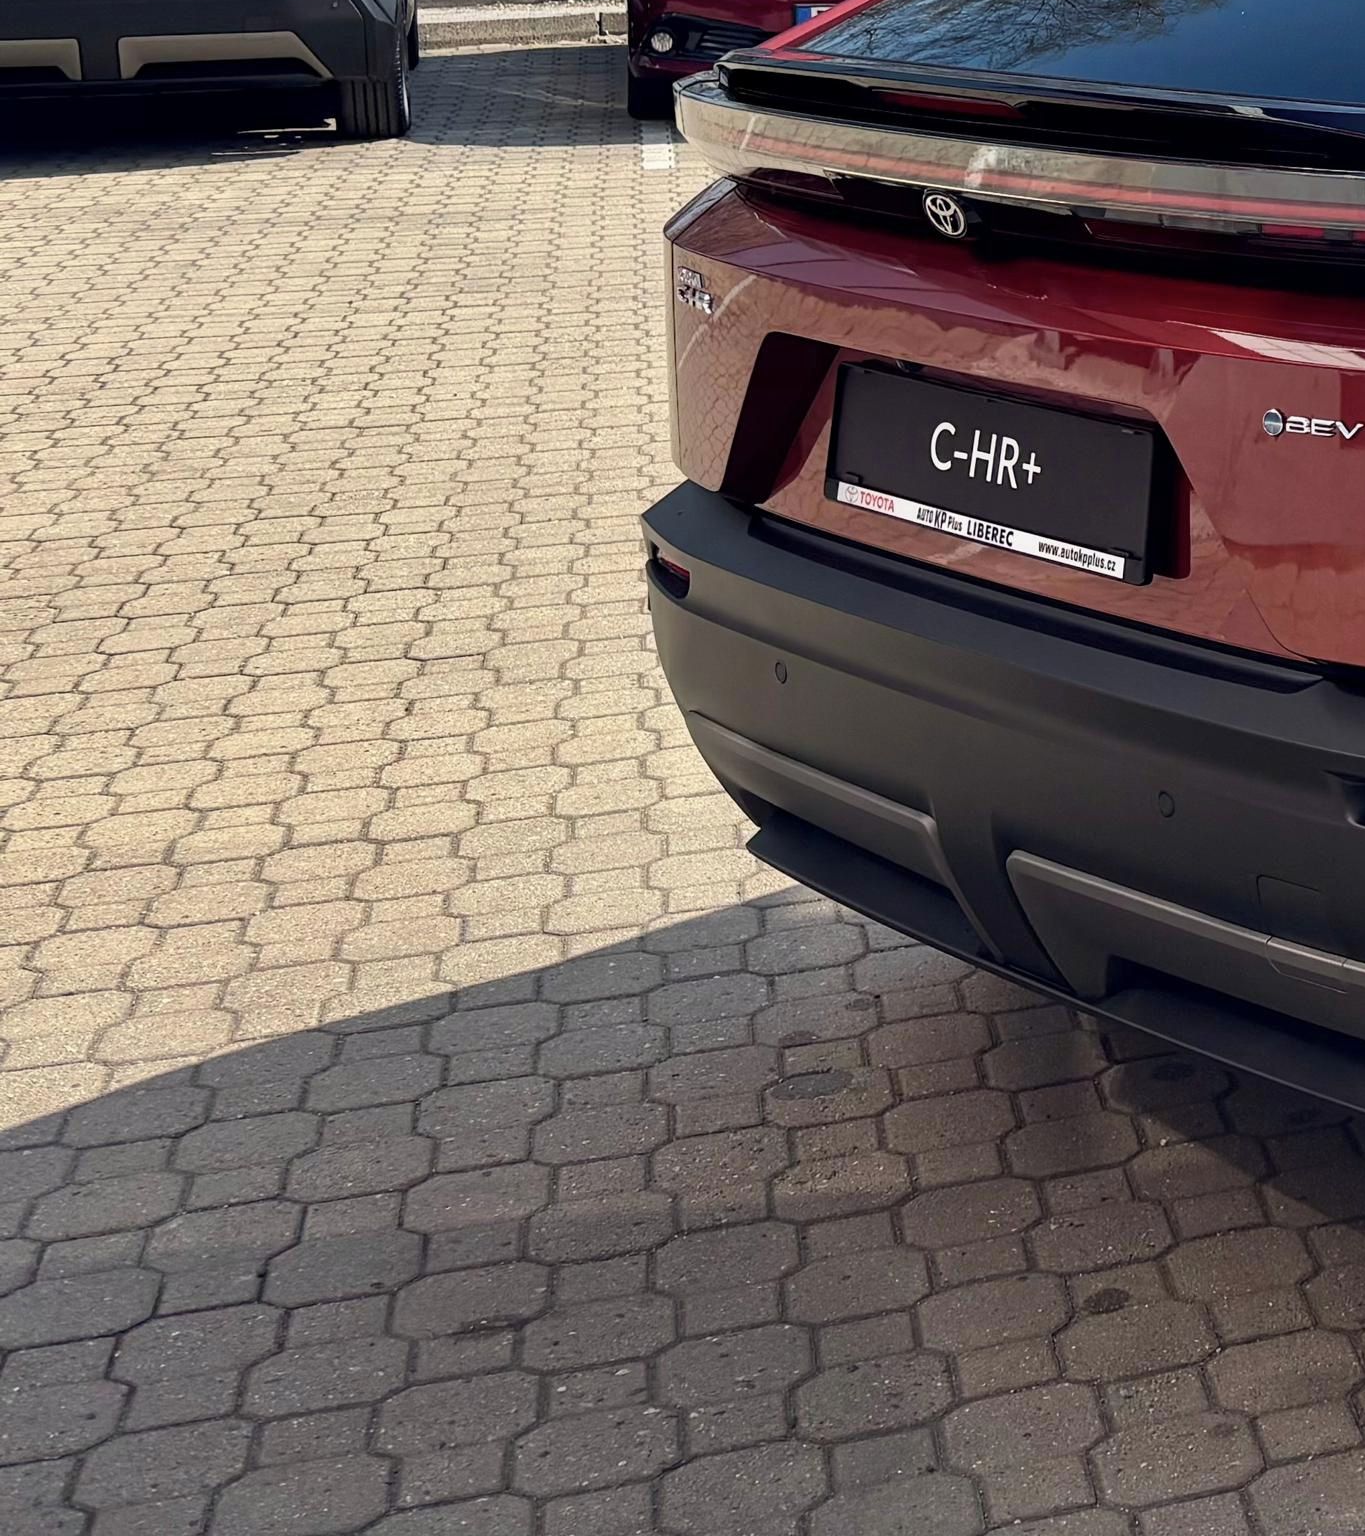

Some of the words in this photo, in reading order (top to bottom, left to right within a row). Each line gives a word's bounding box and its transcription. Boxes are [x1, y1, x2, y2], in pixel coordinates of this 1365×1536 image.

[930, 421, 1042, 489] C-HR+
[1285, 415, 1364, 440] BEV
[859, 490, 895, 513] TOYOTA
[934, 509, 947, 529] KP
[948, 515, 963, 533] Plus
[966, 519, 1015, 547] LIBEREC
[1038, 540, 1117, 573] www.autokpplus.cz
